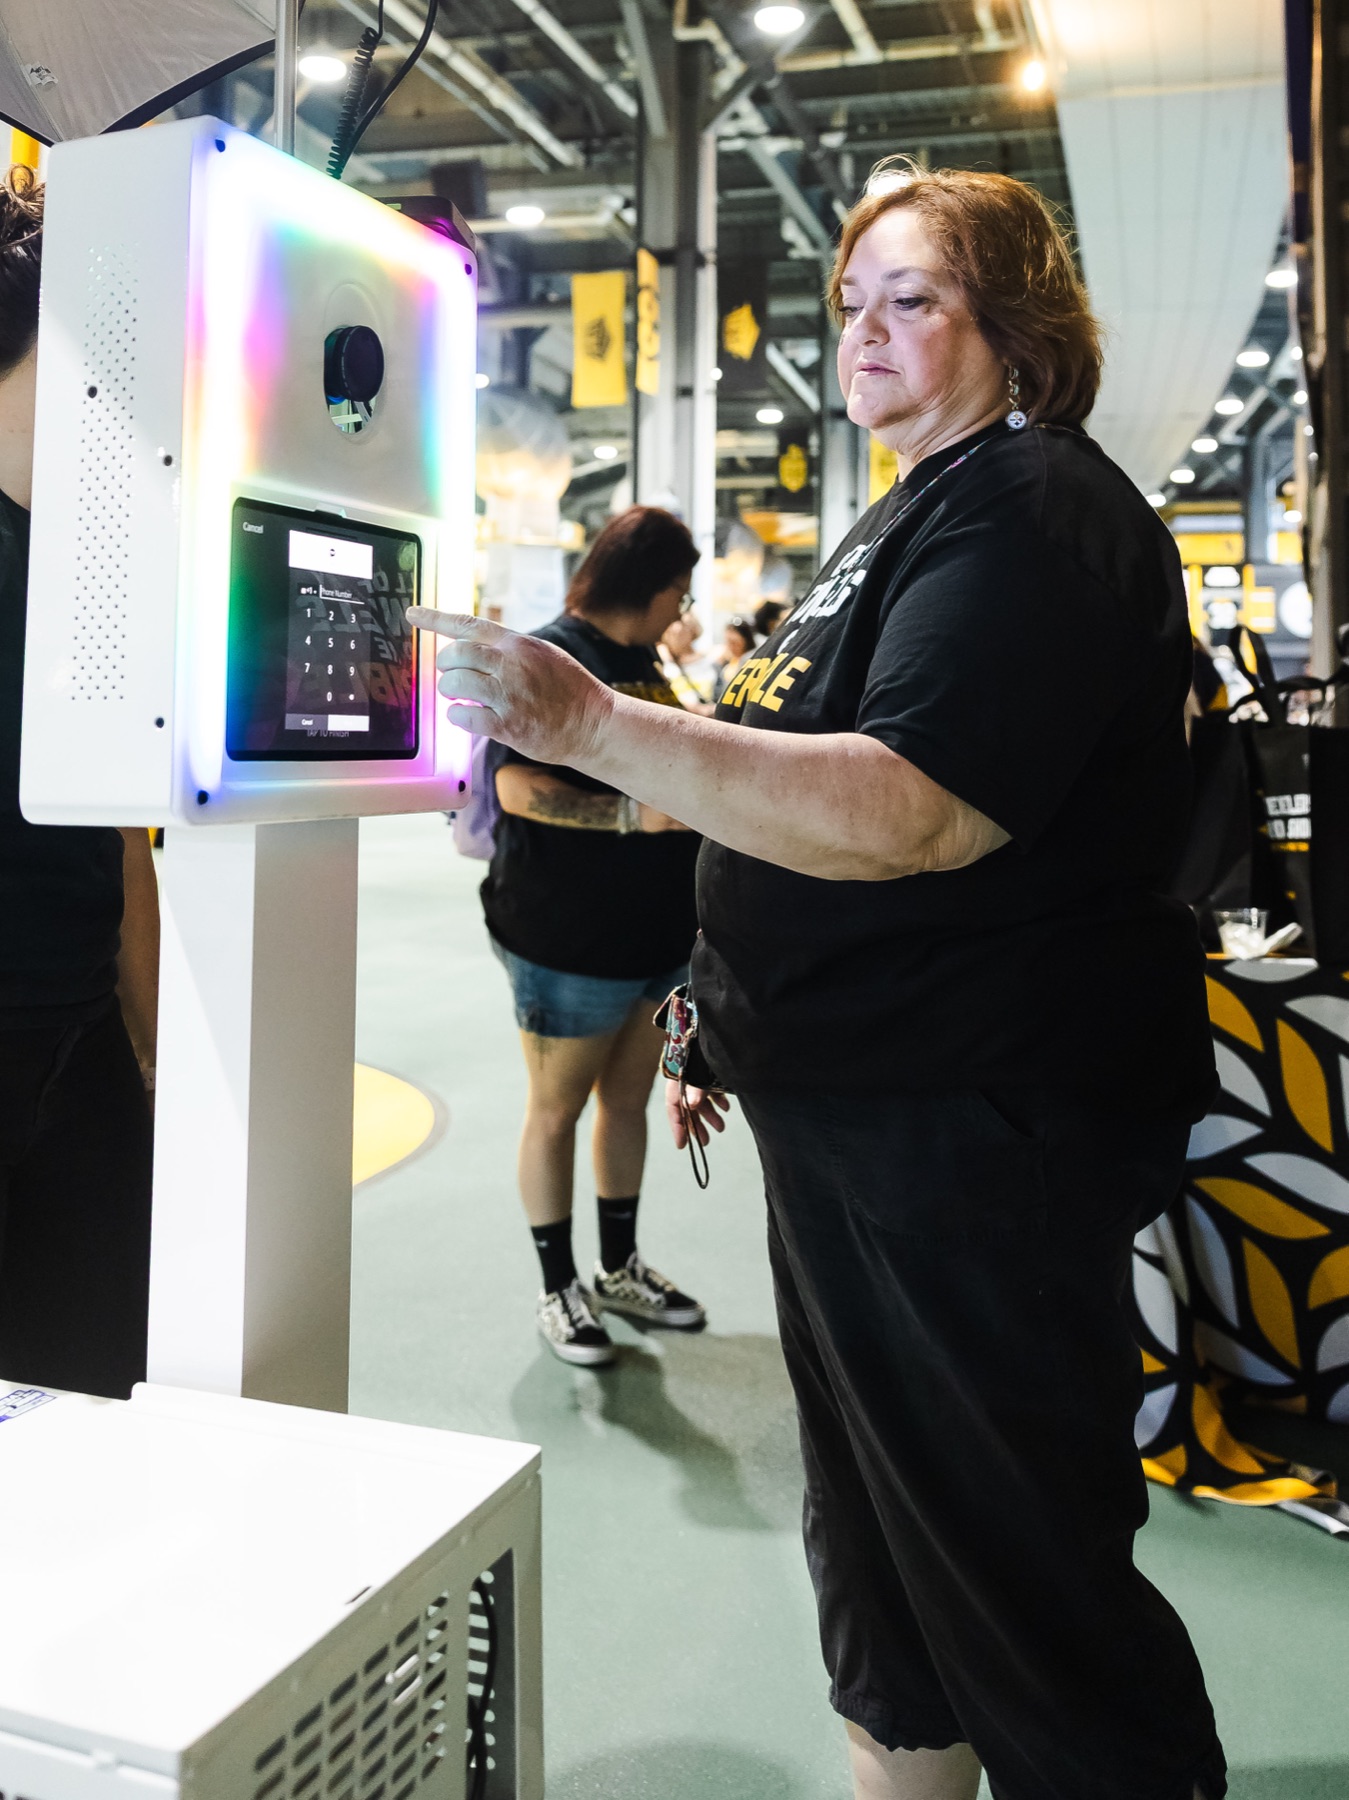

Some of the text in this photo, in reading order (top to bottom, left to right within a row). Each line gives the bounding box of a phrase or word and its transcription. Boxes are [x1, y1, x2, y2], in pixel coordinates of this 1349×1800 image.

[242, 521, 264, 534] Cancel
[321, 587, 335, 597] Phone
[335, 589, 353, 599] Number
[306, 608, 356, 624] 1 2 3
[305, 636, 356, 650] 4 5 6
[304, 663, 355, 676] 7 8 9
[326, 692, 333, 702] 0
